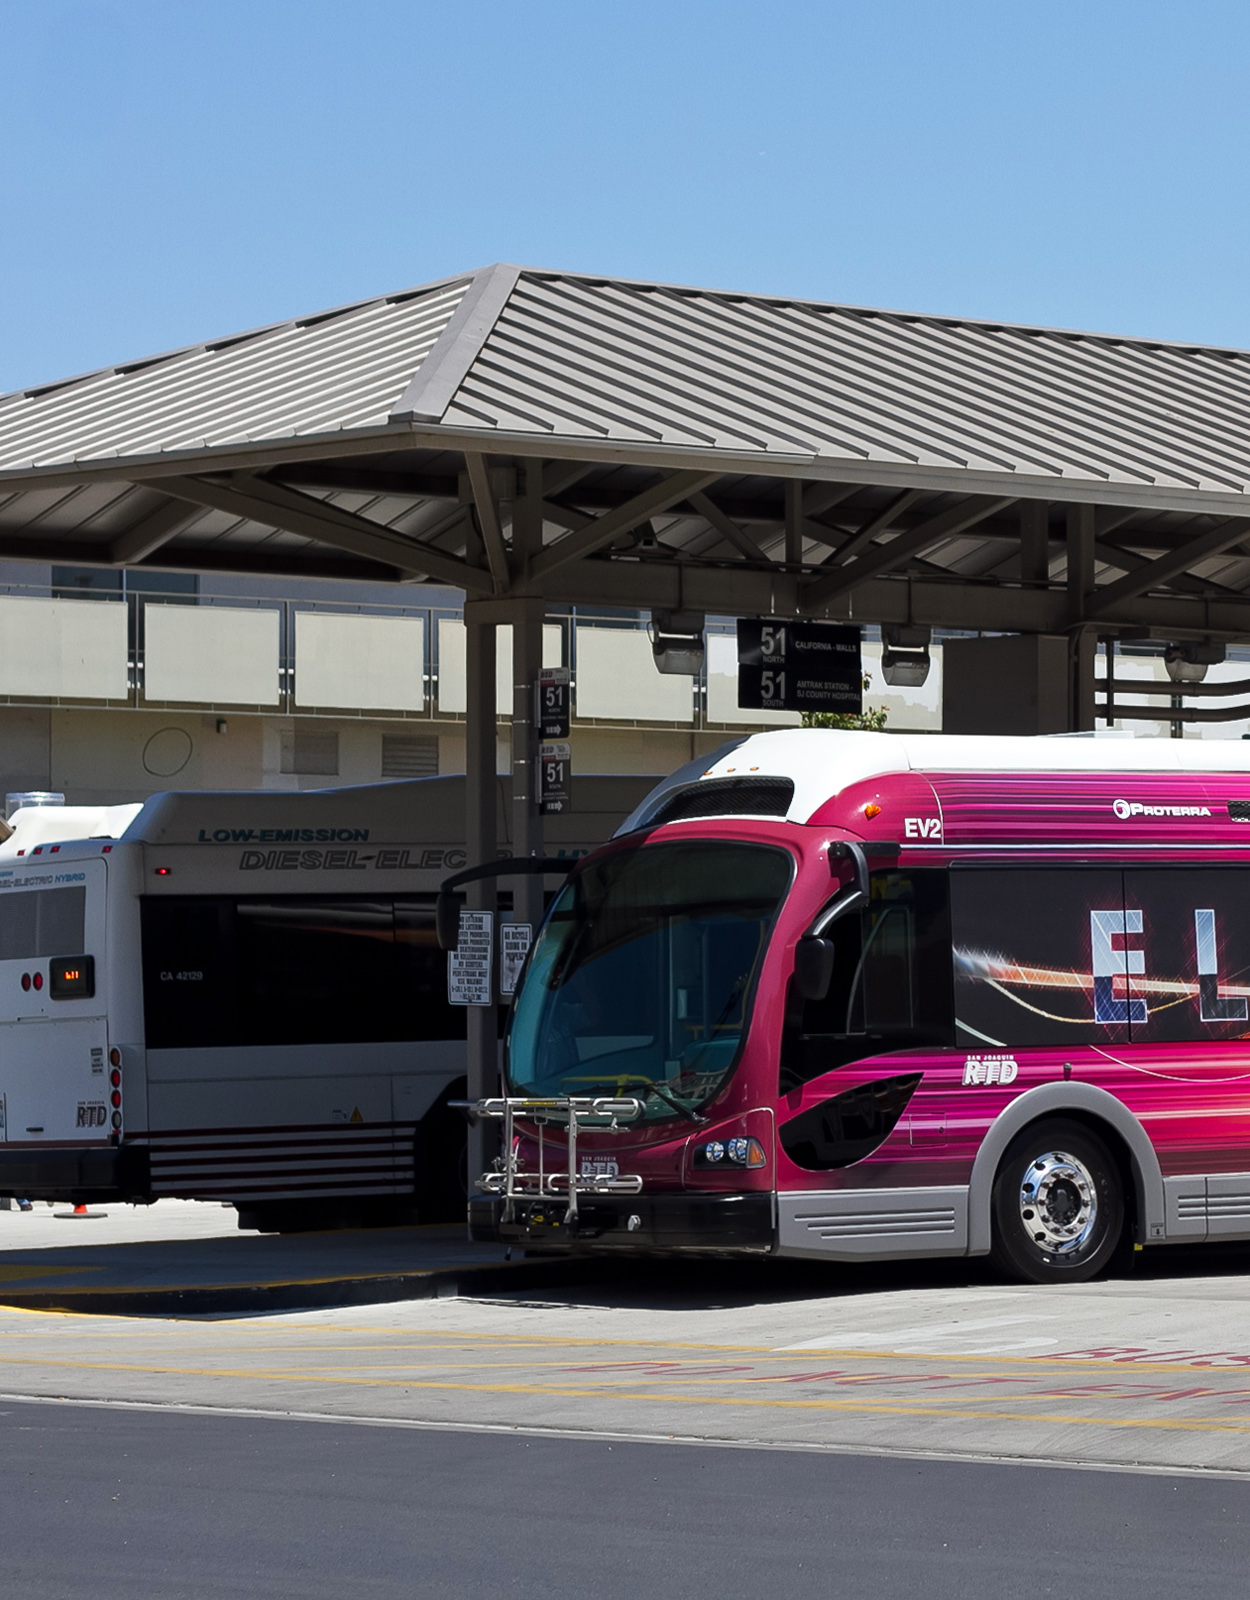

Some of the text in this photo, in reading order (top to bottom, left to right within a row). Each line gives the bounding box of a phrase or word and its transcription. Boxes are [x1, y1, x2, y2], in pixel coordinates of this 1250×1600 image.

[761, 627, 786, 656] 51
[795, 641, 832, 650] CALIFORNIA
[836, 643, 857, 653] MALLS
[763, 656, 785, 664] NORTH
[761, 671, 786, 700] 51
[797, 680, 824, 690] AMTRAK
[824, 682, 850, 690] STATION
[546, 686, 563, 707] 51
[763, 699, 784, 707] SOUTH
[797, 690, 861, 702] SJ COUNTY HOSPITAL
[547, 762, 563, 782] 51
[1129, 803, 1211, 816] PROTERRA
[904, 817, 942, 838] EV2
[199, 829, 370, 843] LOW-EMISSION
[54, 872, 86, 883] HYBRID
[160, 972, 173, 980] CA
[962, 1061, 1018, 1085] RTD
[75, 1106, 107, 1128] RTD
[558, 1362, 755, 1376] DO
[745, 1371, 1045, 1390] NOT
